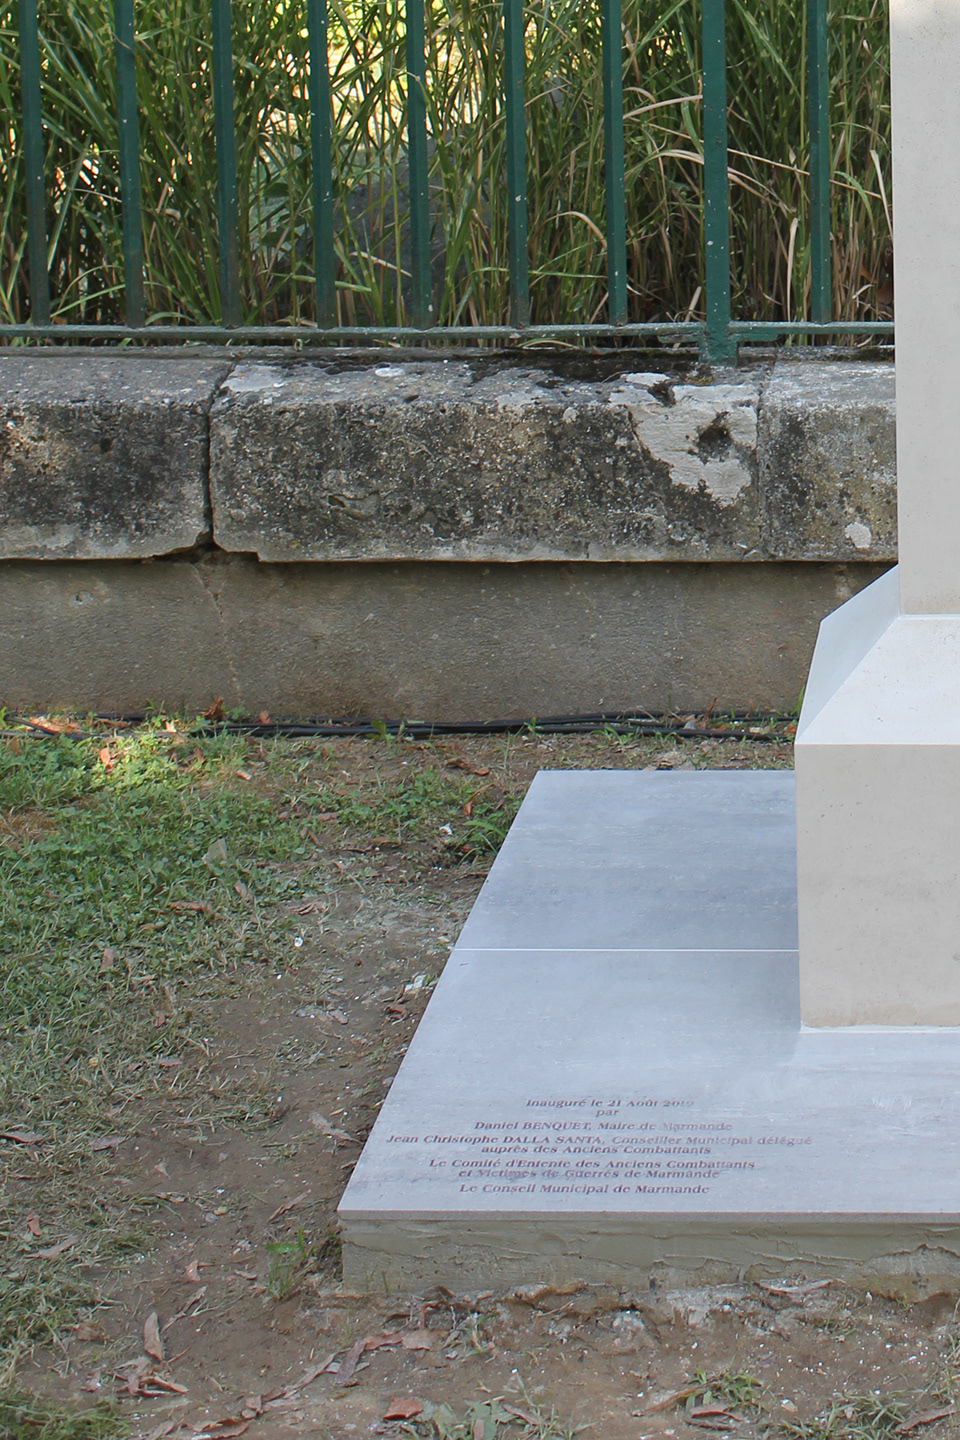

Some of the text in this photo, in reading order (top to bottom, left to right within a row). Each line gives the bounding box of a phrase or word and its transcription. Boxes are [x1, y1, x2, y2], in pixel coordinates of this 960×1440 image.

[526, 1098, 586, 1109] Inauguré
[591, 1099, 603, 1107] le
[626, 1099, 658, 1108] Août
[595, 1109, 619, 1118] par
[474, 1121, 519, 1130] Daniel
[522, 1122, 592, 1132] BENQUET,
[597, 1122, 635, 1131] Maire
[639, 1122, 656, 1131] de
[386, 1134, 419, 1143] Jean
[423, 1135, 499, 1145] Christophe
[502, 1135, 550, 1144] DALLA
[611, 1136, 682, 1145] Conseiller
[686, 1136, 753, 1146] Municipal
[481, 1145, 528, 1154] auprès
[562, 1146, 618, 1154] Anciens
[623, 1145, 712, 1155] Combattants
[429, 1159, 756, 1170] Le Comité d'Entente des Anciens Combattants
[458, 1169, 472, 1177] et
[541, 1170, 559, 1178] de
[624, 1170, 642, 1178] de
[645, 1170, 720, 1178] Marmande
[460, 1184, 710, 1195] Le Conseil Municipal de Marmande
